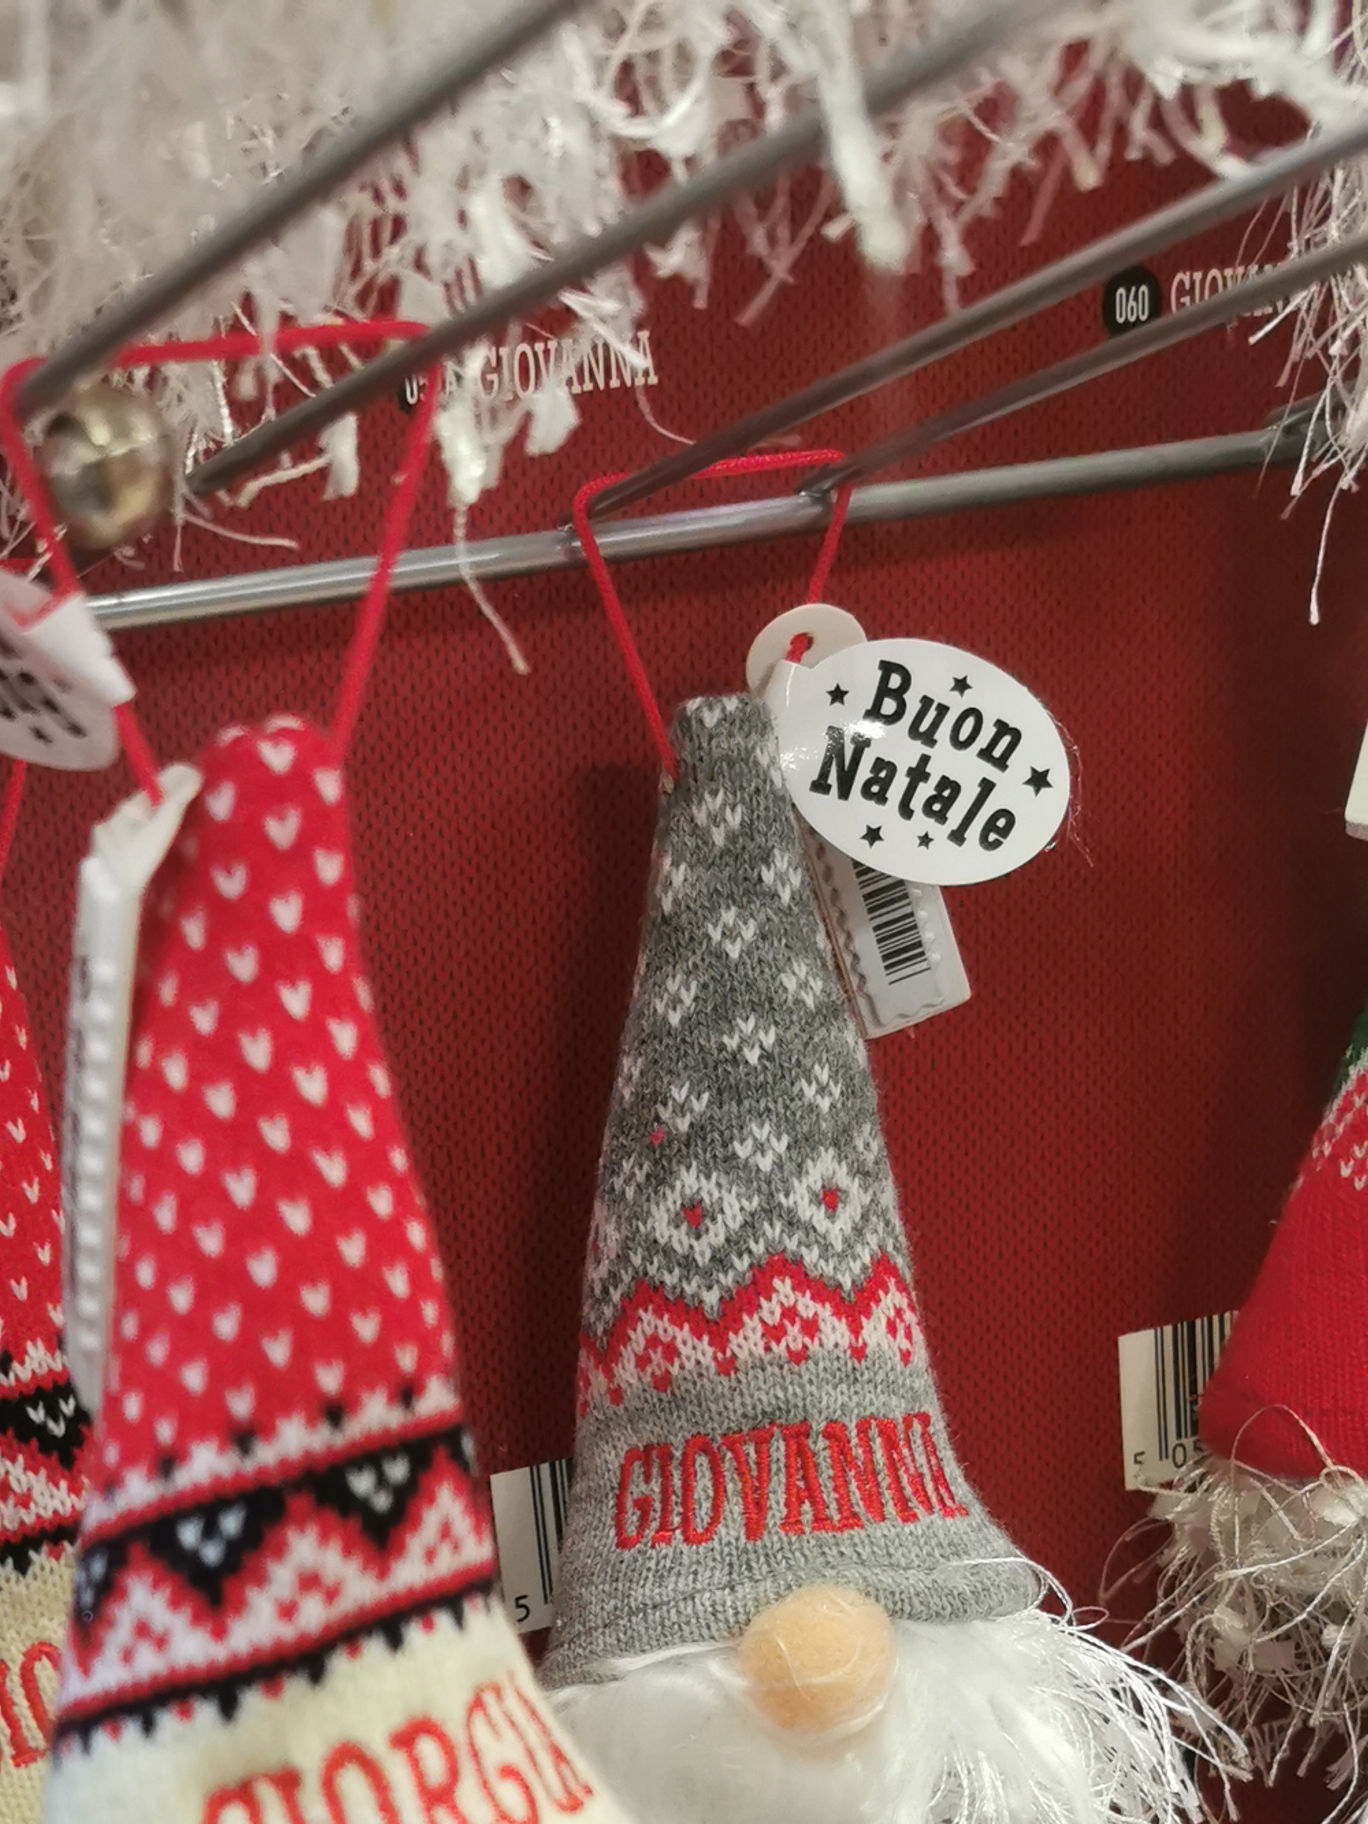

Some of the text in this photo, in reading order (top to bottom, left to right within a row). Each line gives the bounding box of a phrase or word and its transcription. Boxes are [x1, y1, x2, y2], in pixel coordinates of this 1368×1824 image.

[1115, 284, 1150, 325] 060
[862, 658, 1023, 774] Buon
[808, 725, 1018, 852] Natale
[614, 1411, 971, 1550] GIOVANNA
